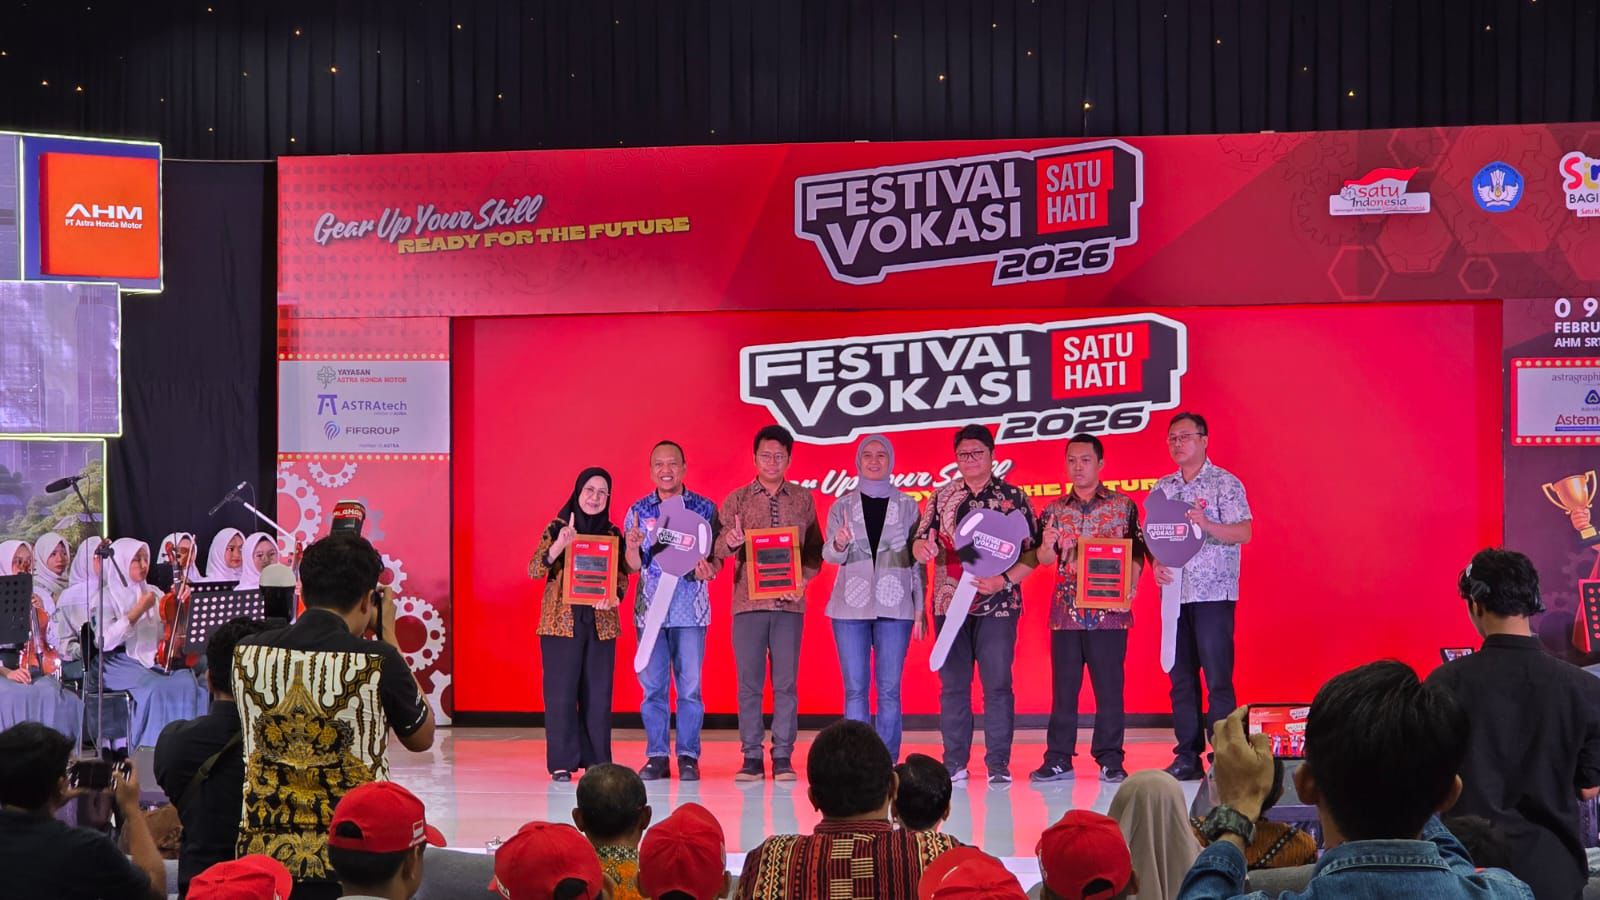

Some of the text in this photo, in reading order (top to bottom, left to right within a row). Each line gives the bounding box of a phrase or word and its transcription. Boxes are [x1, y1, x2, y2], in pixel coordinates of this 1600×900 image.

[807, 162, 1021, 221] FESTIVAL
[1046, 159, 1101, 193] SATU
[1359, 184, 1399, 199] satu
[65, 203, 143, 220] AHM
[1047, 191, 1096, 225] HATI
[1350, 197, 1407, 208] Indonesia
[76, 219, 95, 227] Astra
[96, 220, 119, 228] Honda
[120, 221, 143, 229] Motor
[313, 194, 543, 246] Gear Up Your Skill
[397, 217, 690, 254] READY FOR THE FUTURE
[827, 201, 1021, 265] VOKASI
[1000, 240, 1111, 279] 2026
[1063, 331, 1134, 362] SATU
[1554, 337, 1581, 348] AHM
[755, 333, 1031, 387] FESTIVAL
[1064, 361, 1127, 390] HATI
[341, 400, 407, 411] ASTRAtech
[781, 370, 1032, 428] VOKASI
[345, 426, 400, 435] FIFGROUP
[1001, 406, 1144, 440] 2026
[821, 469, 860, 498] Up
[1018, 483, 1062, 497] HE
